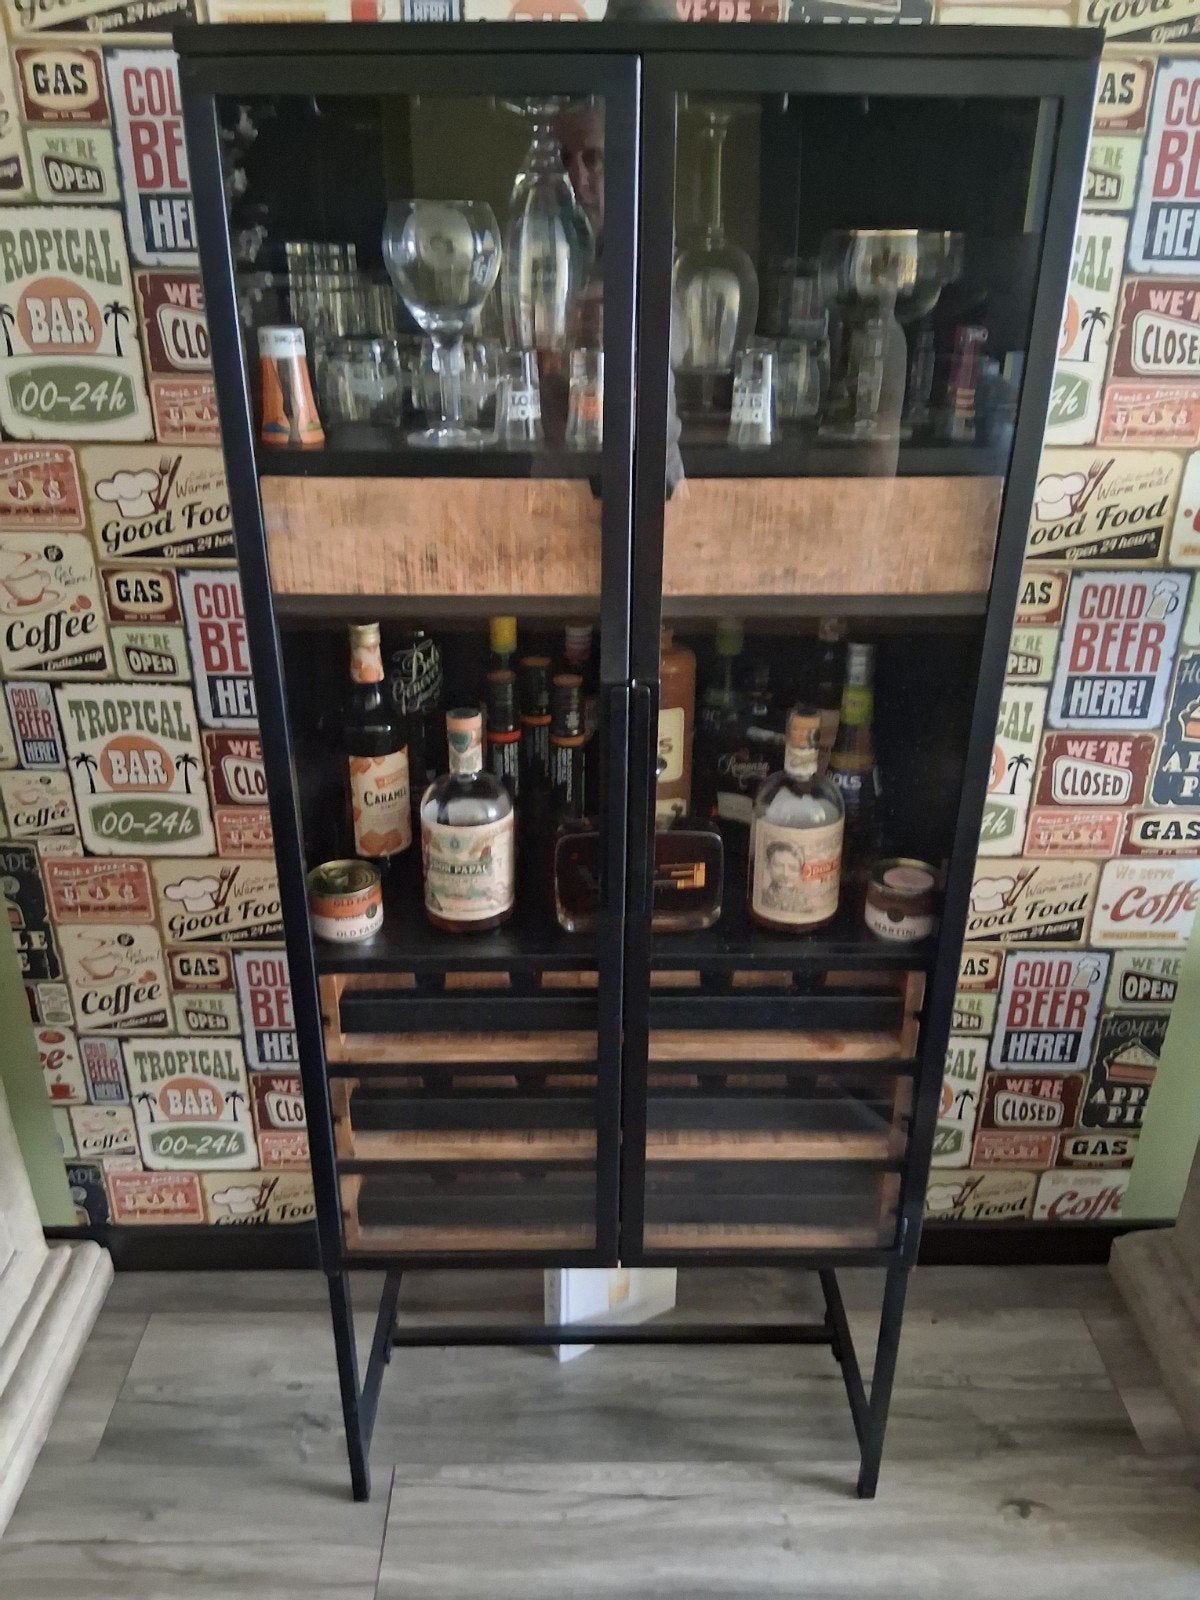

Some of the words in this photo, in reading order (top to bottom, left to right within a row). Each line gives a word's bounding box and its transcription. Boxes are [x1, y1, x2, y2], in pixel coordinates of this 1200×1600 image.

[32, 63, 88, 95] GAS
[49, 161, 101, 190] OPEN
[26, 297, 95, 343] BAR
[21, 376, 126, 412] 00-24h
[176, 479, 210, 498] Warm
[1097, 484, 1134, 500] Warm
[1096, 495, 1169, 530] Food
[101, 510, 175, 553] Good
[116, 579, 164, 603] GAS
[1078, 584, 1147, 620] COLD
[6, 611, 98, 653] Coffee
[130, 651, 173, 672] OPEN
[1068, 622, 1166, 673] BEER
[11, 687, 38, 709] COLD
[1068, 679, 1147, 717] HERE!
[16, 709, 54, 738] BEER
[68, 699, 192, 742] TROPICAL
[1066, 740, 1133, 767] WE'RE
[107, 750, 168, 786] BAR
[1060, 766, 1124, 796] CLOSED
[363, 786, 408, 807] CARAMEL
[14, 807, 70, 828] Coffee
[101, 806, 194, 836] 00-24h
[1140, 821, 1200, 840] GAS
[1025, 892, 1089, 920] Food
[168, 906, 231, 939] Good
[179, 957, 220, 976] GAS
[1013, 961, 1073, 988] COLD
[81, 982, 161, 1016] Coffee
[1124, 975, 1175, 1000] OPEN
[188, 1012, 227, 1030] OPEN
[1006, 989, 1091, 1029] BEER
[1008, 1033, 1075, 1061] HERE!
[133, 1050, 241, 1083] TROPICAL
[1006, 1078, 1064, 1099] WE'RE
[167, 1089, 218, 1117] BAR
[1002, 1098, 1057, 1122] CLOSED
[82, 1133, 131, 1149] Coffee
[158, 1132, 240, 1155] 00-24h
[1072, 1141, 1128, 1156] GAS
